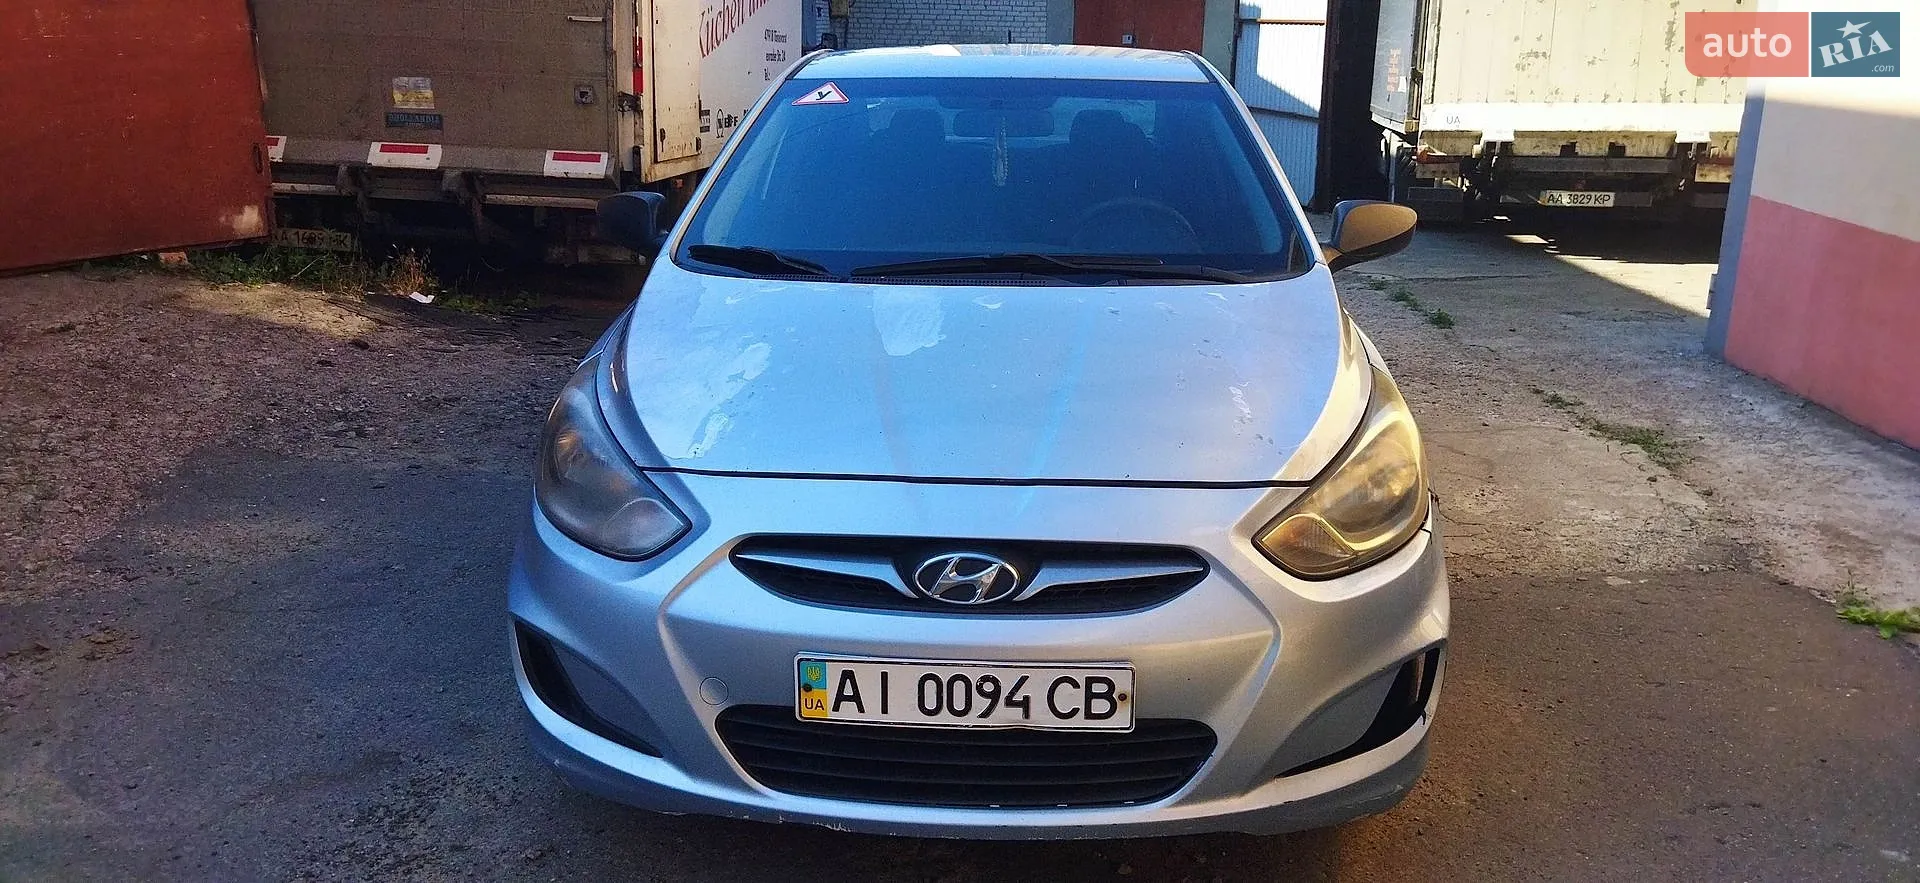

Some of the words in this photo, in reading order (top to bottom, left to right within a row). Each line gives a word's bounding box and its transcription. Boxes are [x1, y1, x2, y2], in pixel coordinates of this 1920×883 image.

[1446, 116, 1461, 125] UA
[1547, 193, 1563, 205] AA
[1566, 193, 1593, 205] 3829
[1593, 194, 1611, 205] KP
[831, 668, 889, 715] AI
[917, 672, 1031, 720] 0094
[1046, 675, 1118, 720] CB
[804, 697, 825, 711] UA
